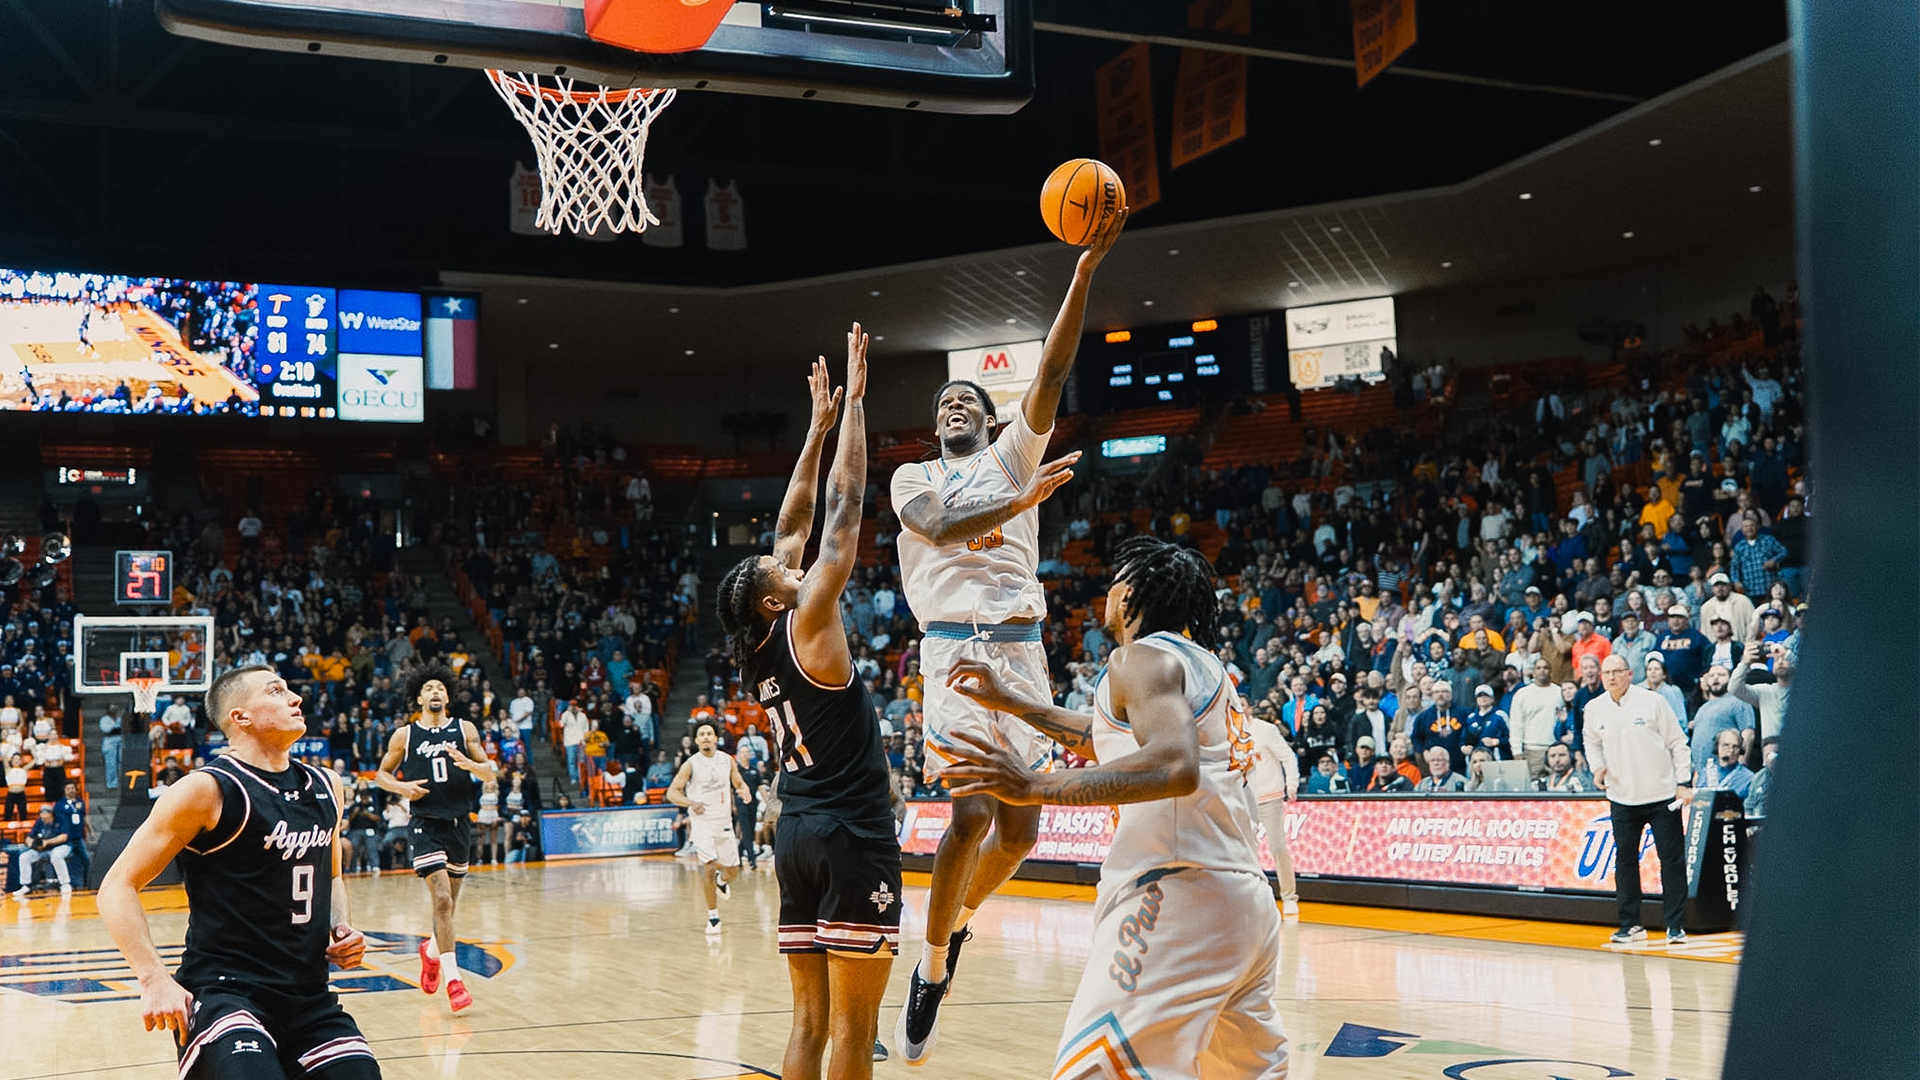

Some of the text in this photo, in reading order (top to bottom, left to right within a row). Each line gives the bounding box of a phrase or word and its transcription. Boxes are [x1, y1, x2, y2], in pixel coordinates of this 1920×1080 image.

[366, 315, 421, 332] WestStar
[267, 331, 328, 355] 81 74
[279, 360, 315, 382] 2:10
[983, 352, 1010, 371] M
[341, 388, 418, 409] GECU
[126, 571, 161, 598] 27
[431, 756, 448, 783] 0
[603, 817, 673, 833] MINER
[1051, 812, 1107, 836] PASO'S
[1386, 817, 1559, 839] AN OFFICIAL ROOFER
[263, 819, 333, 861] Aggies
[1388, 841, 1546, 867] OF UTEP ATHLETICS
[1722, 824, 1739, 911] CHEVROLET
[290, 864, 315, 925] 9
[1118, 881, 1165, 955] Paso
